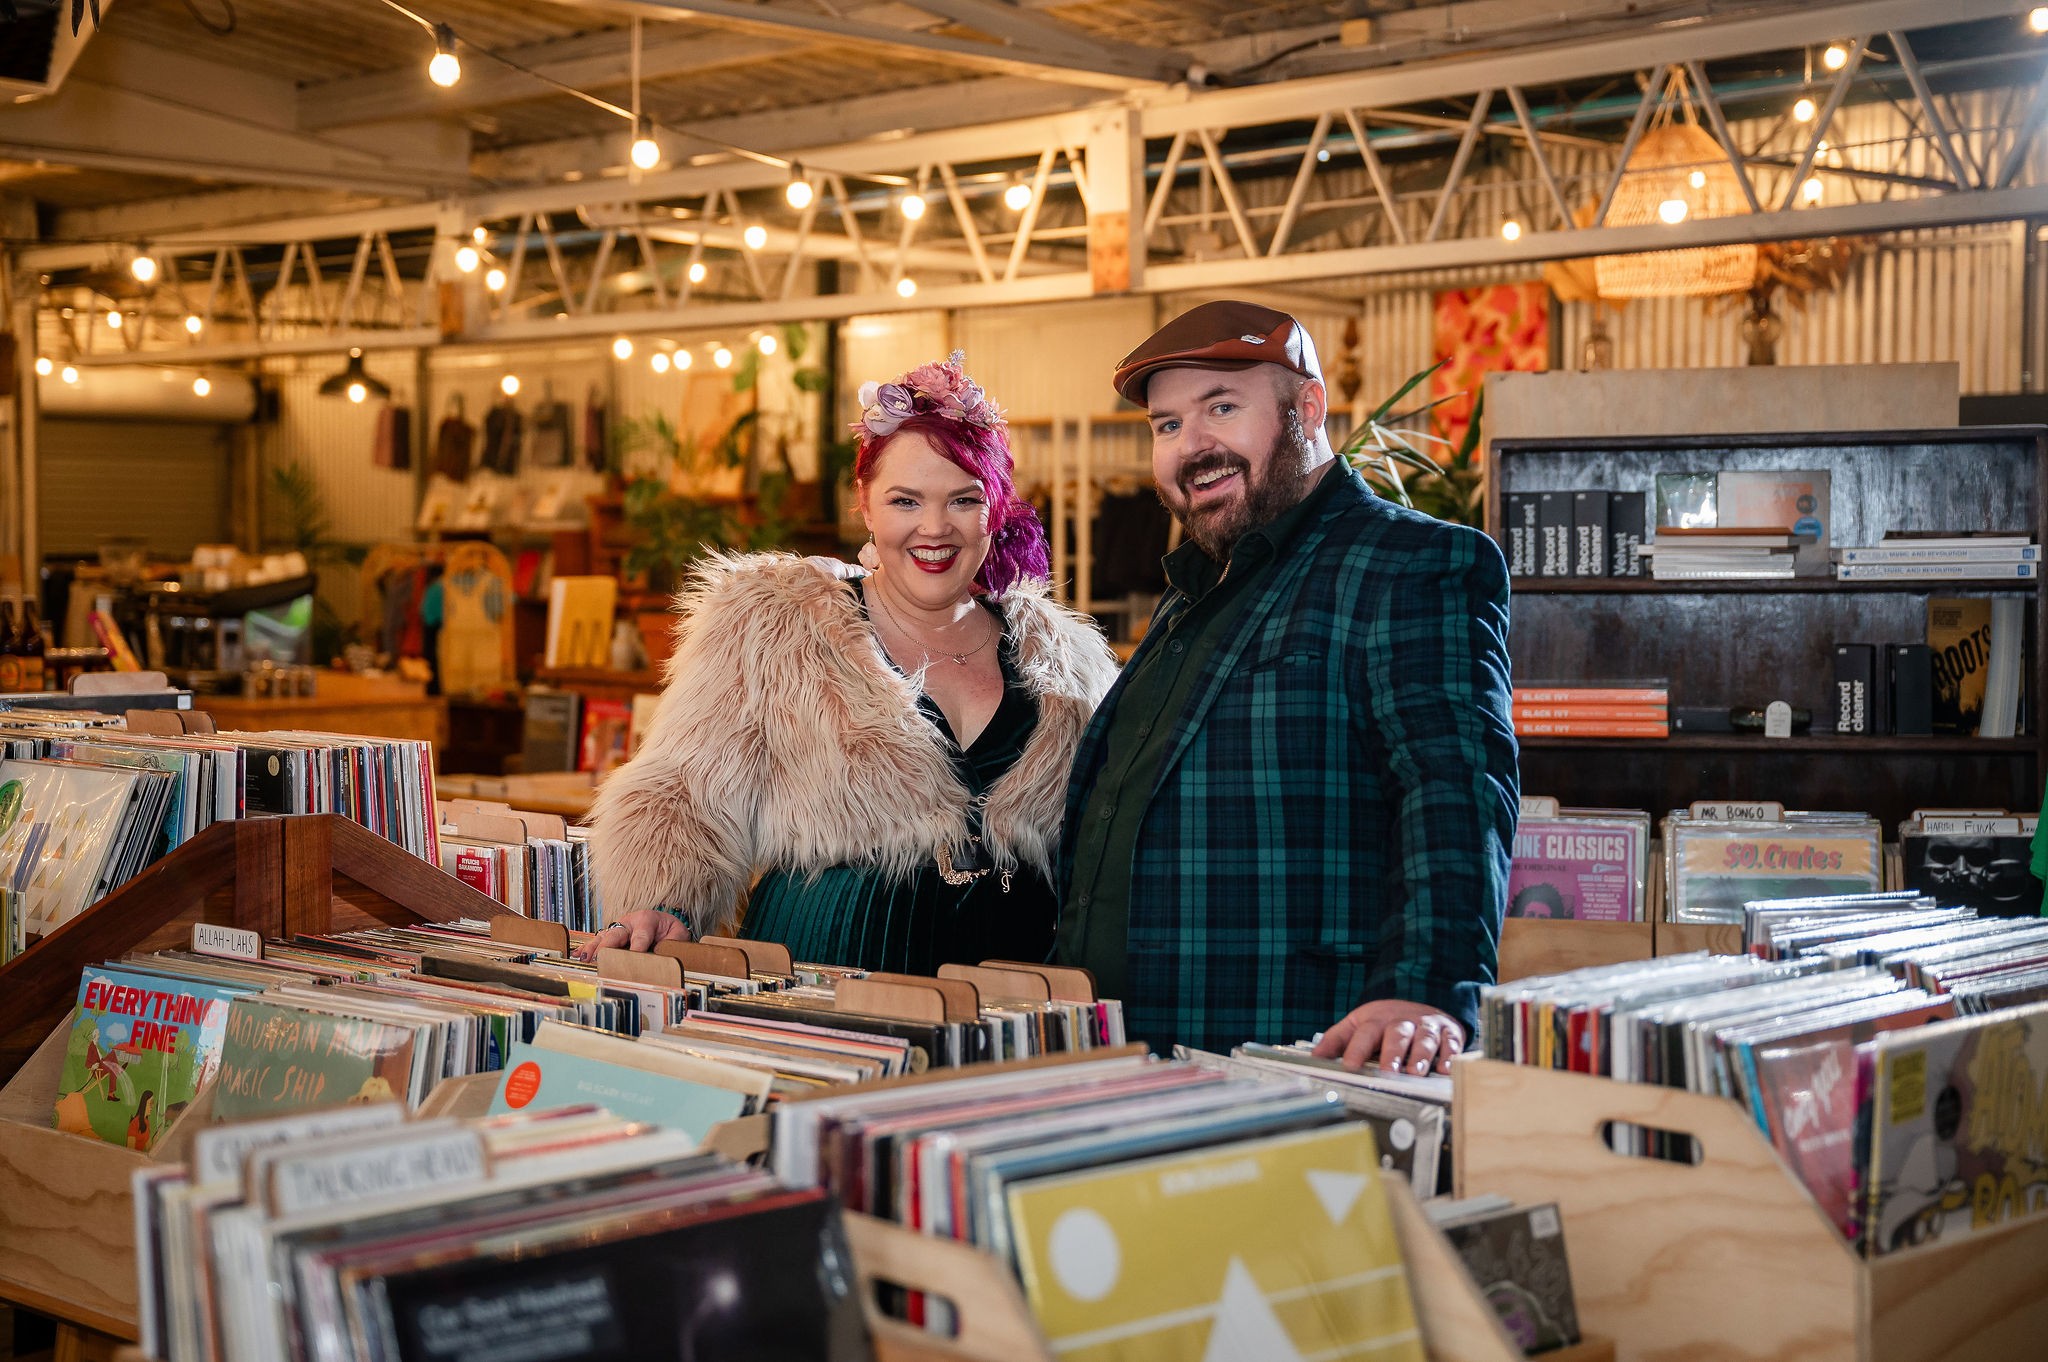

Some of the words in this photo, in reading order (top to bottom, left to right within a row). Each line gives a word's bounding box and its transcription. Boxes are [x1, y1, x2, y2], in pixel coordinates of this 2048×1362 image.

[1523, 503, 1535, 525] set
[1510, 527, 1523, 576] Record
[1523, 526, 1535, 575] cleaner
[1543, 526, 1556, 576] Record
[1556, 524, 1568, 575] cleaner
[1576, 526, 1589, 576] Record
[1590, 524, 1602, 575] cleaner
[1614, 532, 1627, 576] Velvet
[1627, 534, 1640, 576] brush
[1932, 624, 1992, 693] ROOTS
[1522, 693, 1551, 701] BLACK
[1522, 709, 1551, 718] BLACK
[1554, 709, 1569, 718] IVY
[1838, 681, 1851, 732] Record
[1852, 680, 1864, 732] cleaner
[1523, 724, 1552, 733] BLACK
[1554, 724, 1569, 733] IVY
[1701, 806, 1718, 820] MR
[1726, 805, 1765, 820] BONGO
[1964, 820, 1997, 834] FUNK
[462, 857, 480, 866] RYUICHI
[1546, 835, 1625, 861] CLASSICS
[458, 864, 483, 873] SAKAMOTO
[199, 927, 253, 955] ALLAH-LAHS
[129, 1019, 179, 1054] FINE
[326, 1022, 385, 1062] MAN
[216, 1062, 271, 1099] MAGIC
[273, 1065, 326, 1103] SHIP
